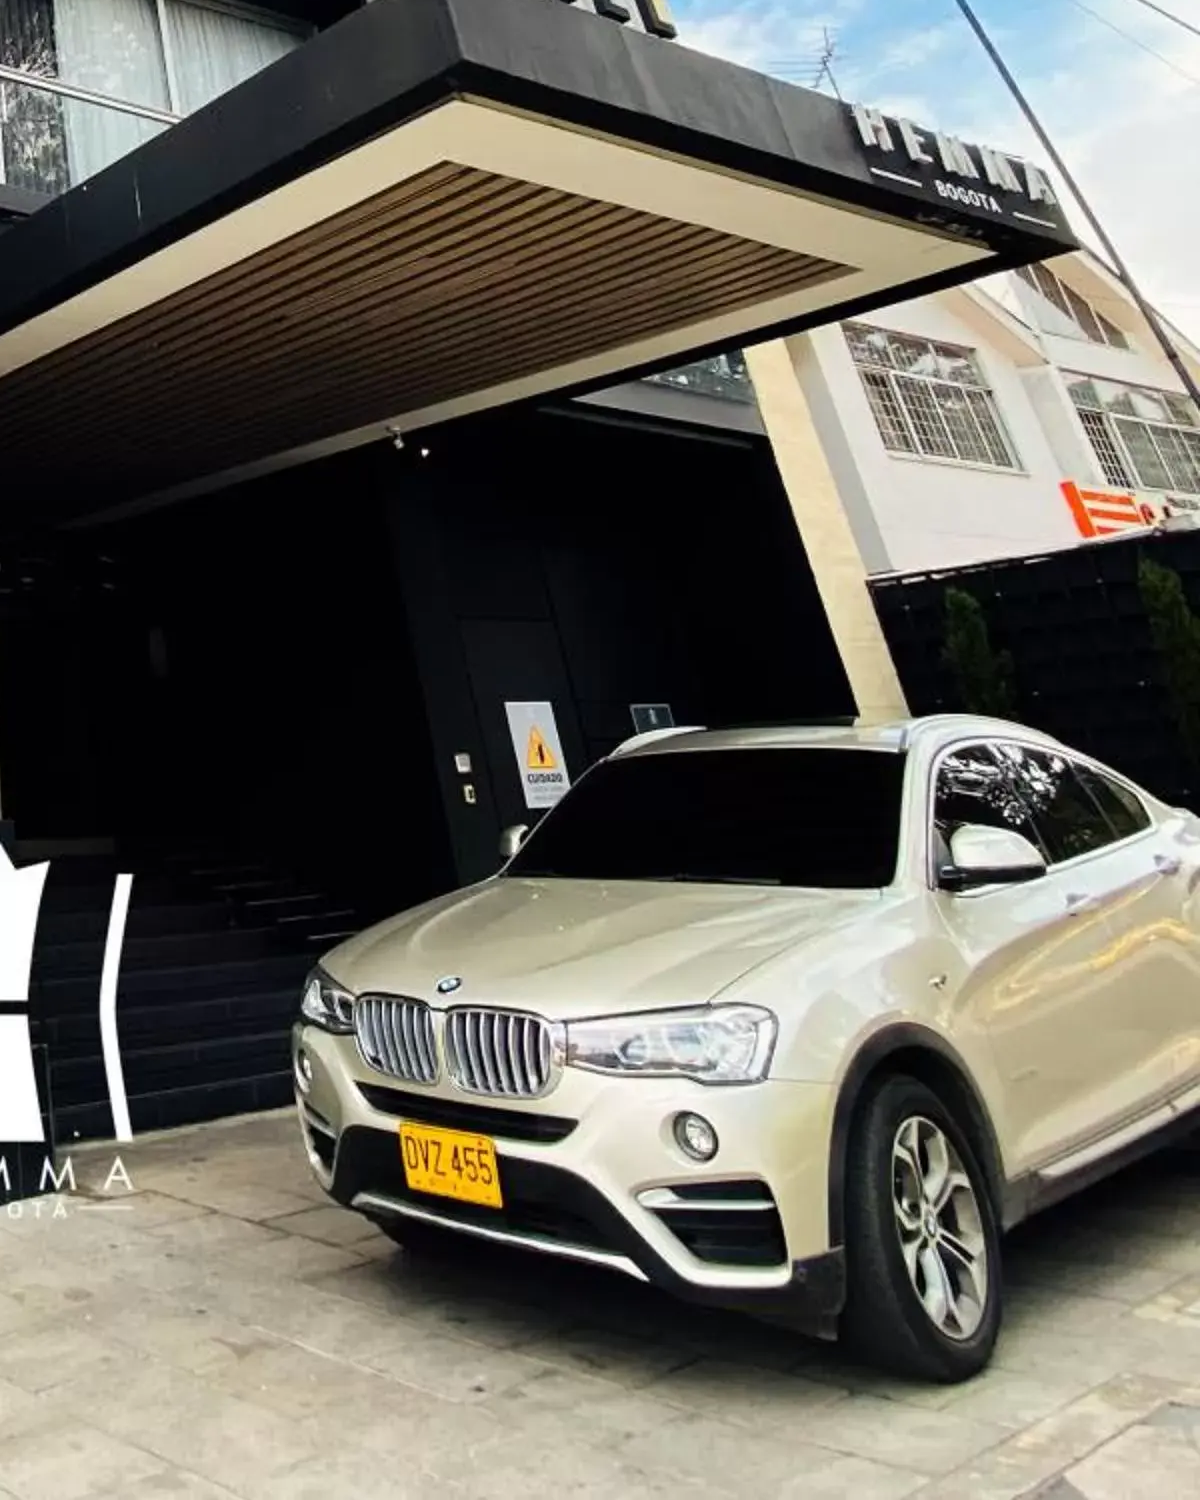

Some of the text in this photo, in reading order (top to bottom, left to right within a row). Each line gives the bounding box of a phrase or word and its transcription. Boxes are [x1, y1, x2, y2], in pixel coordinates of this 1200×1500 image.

[853, 103, 1057, 205] HEMMA
[933, 179, 1003, 213] BOGOTA
[404, 1135, 493, 1186] DVZ 455
